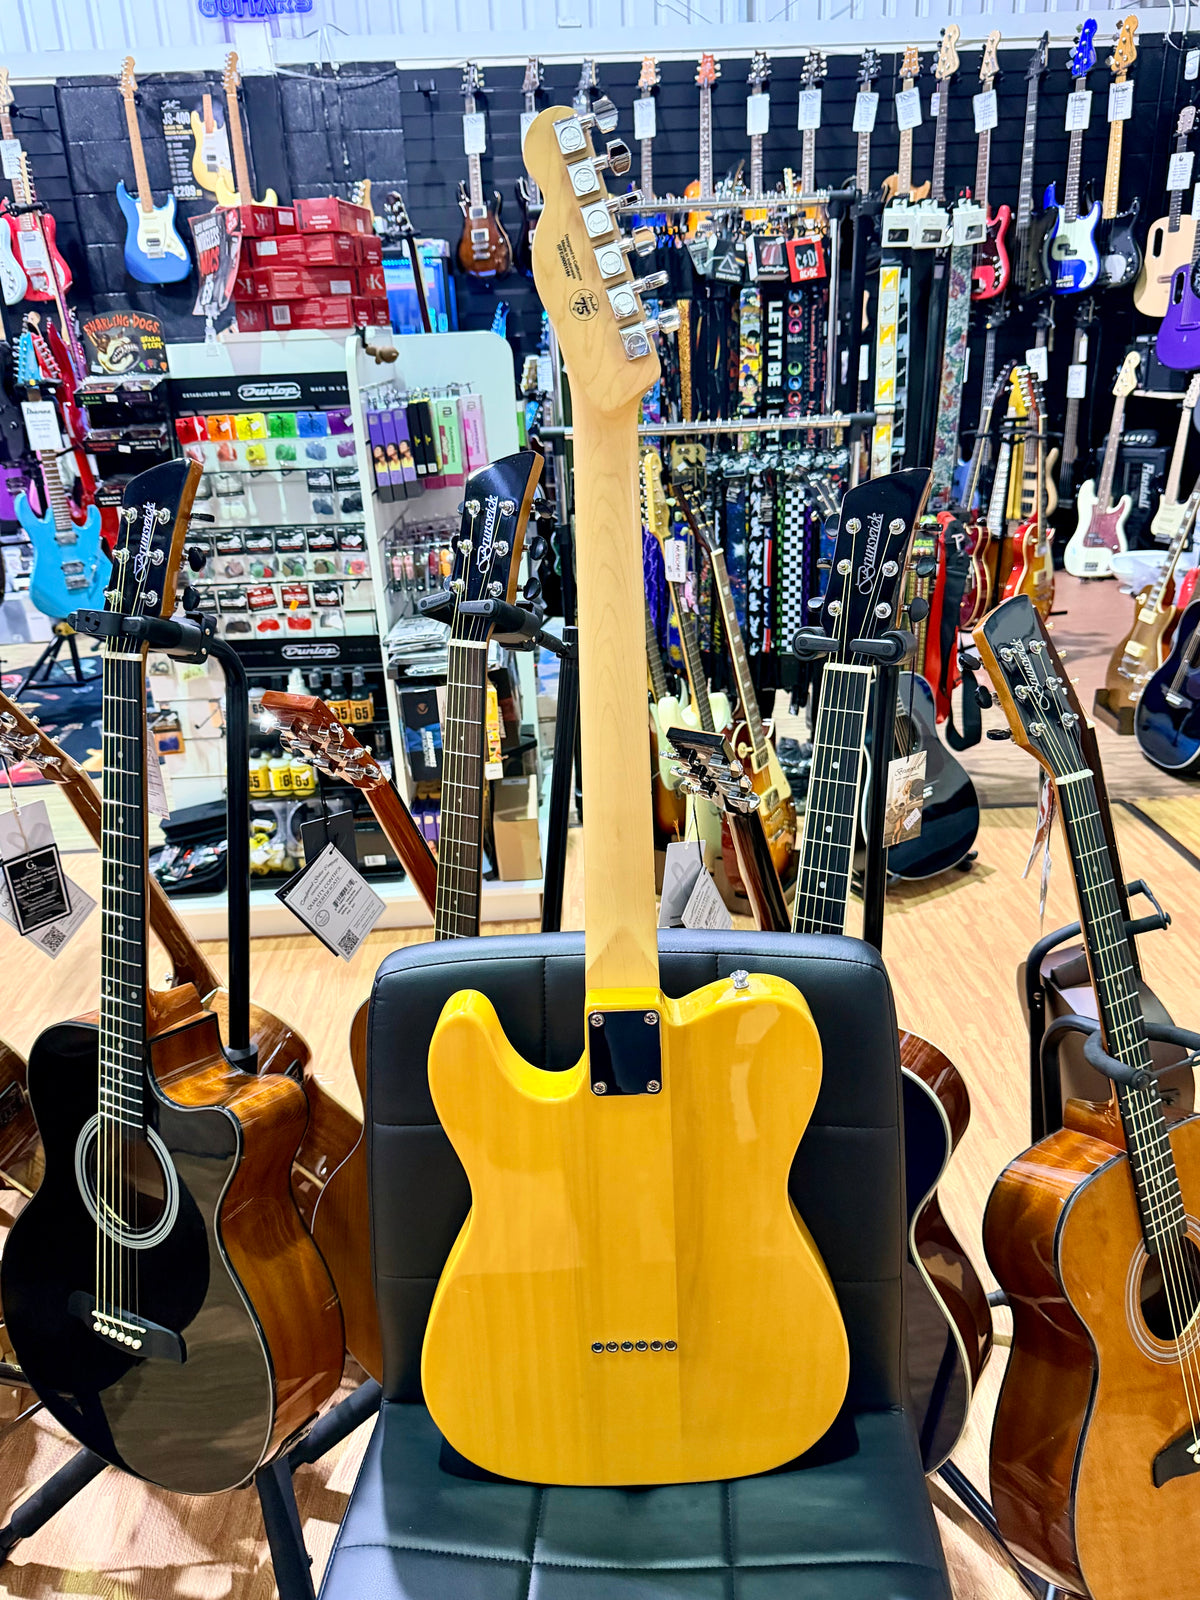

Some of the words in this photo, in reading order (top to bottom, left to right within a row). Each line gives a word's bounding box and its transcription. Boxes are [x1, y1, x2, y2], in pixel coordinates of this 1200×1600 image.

[162, 112, 191, 125] JS-400
[799, 268, 818, 279] AC/DC
[83, 314, 130, 337] SNARLING
[132, 313, 160, 333] DOGS
[767, 300, 783, 337] LET
[767, 339, 782, 359] IT
[767, 362, 782, 388] BE
[241, 384, 299, 399] Dunlop
[1138, 463, 1155, 509] Randall
[133, 501, 156, 582] Brunswick
[476, 495, 499, 573] Brunswick
[855, 512, 884, 594] Brunswick
[285, 645, 337, 658] Dunlop
[355, 707, 369, 720] 65
